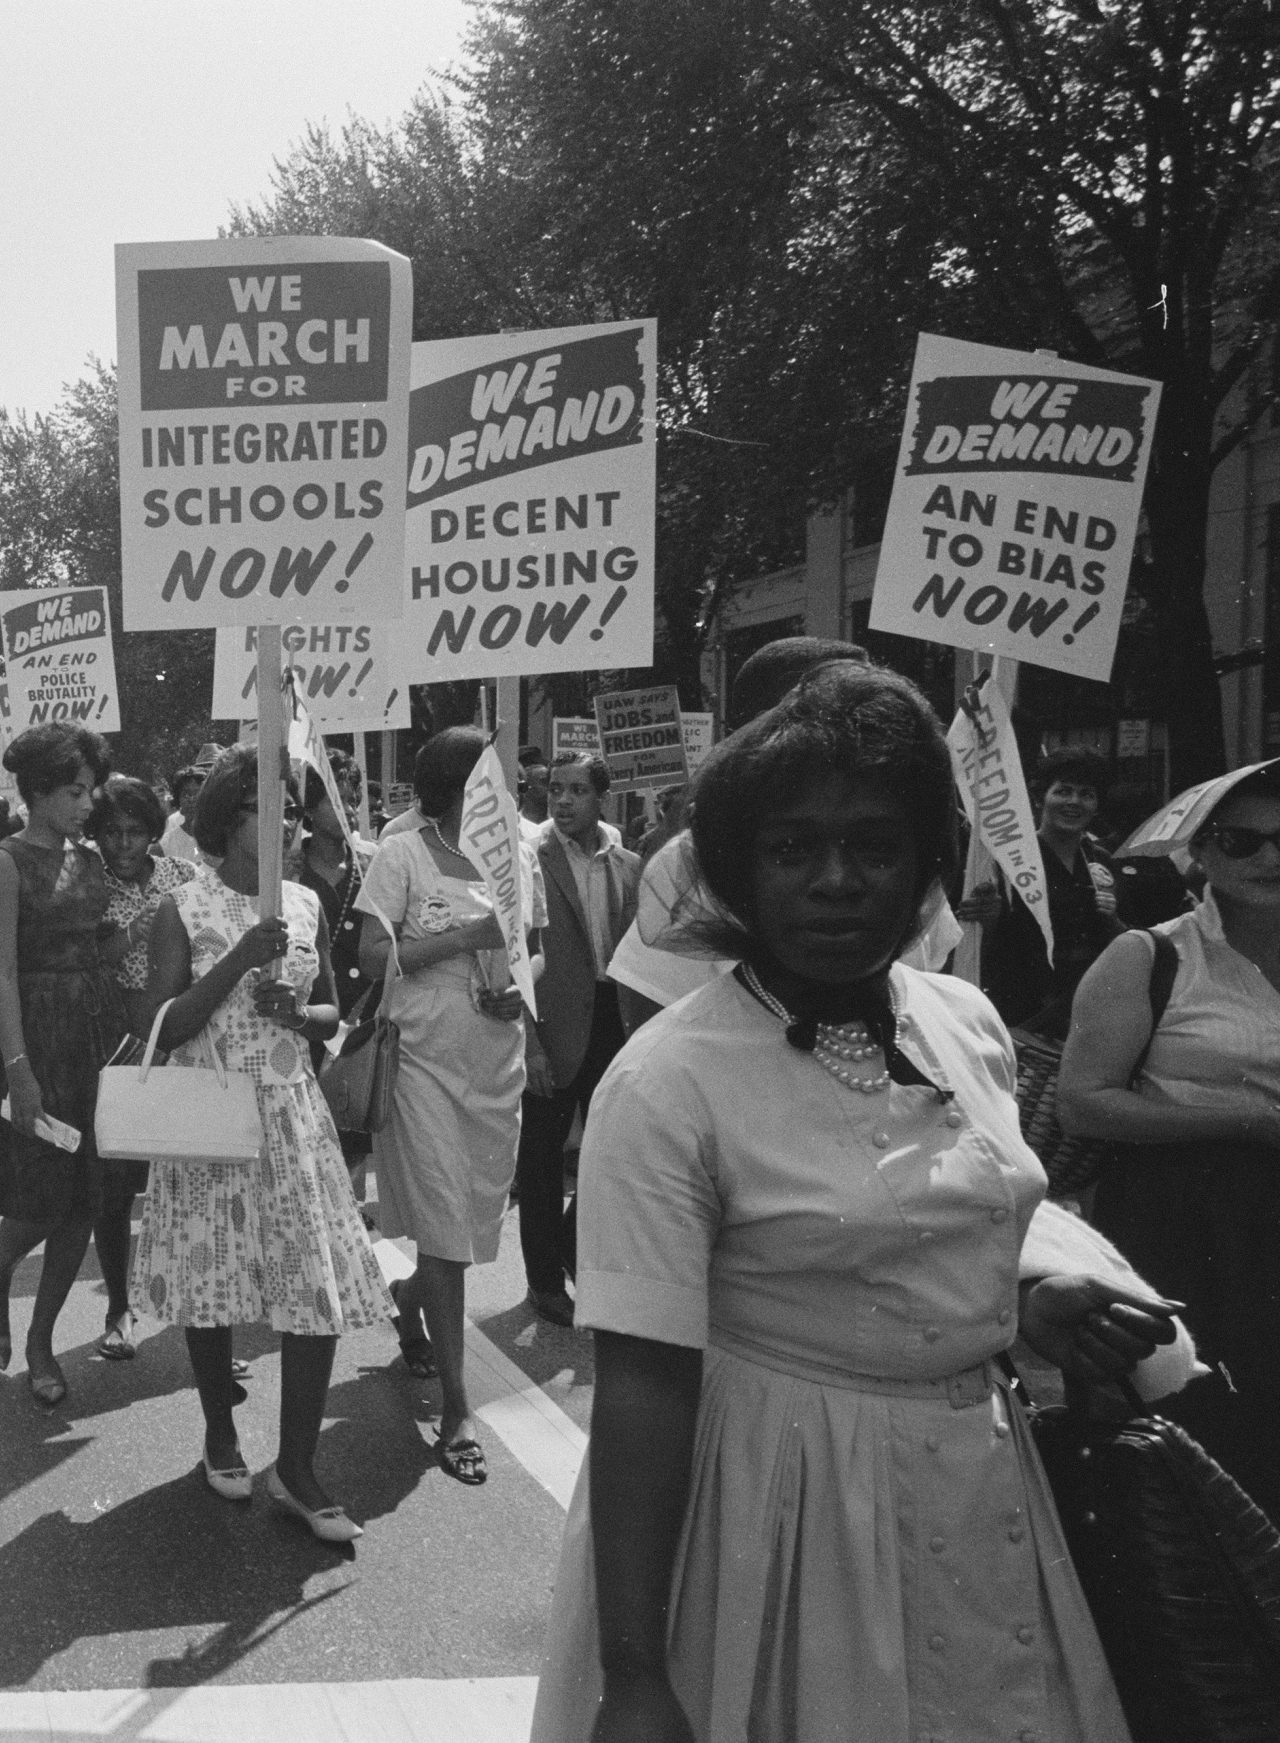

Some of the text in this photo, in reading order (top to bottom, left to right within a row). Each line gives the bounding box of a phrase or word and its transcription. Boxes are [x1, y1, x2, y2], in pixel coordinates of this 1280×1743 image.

[228, 275, 302, 313] WE
[159, 318, 371, 370] MARCH
[226, 375, 307, 399] FOR
[470, 354, 562, 421] WE
[990, 381, 1079, 420] WE
[141, 418, 388, 468] INTEGRATED
[408, 385, 635, 494] DEMAND
[923, 422, 1134, 467] DEMAND
[143, 479, 384, 528] SCHOOLS
[431, 491, 621, 543] DECENT
[922, 484, 1117, 552] AN END
[161, 532, 374, 602] NOW!
[412, 546, 639, 600] HOUSING
[922, 526, 1107, 596] TO BIAS
[37, 596, 73, 622] WE
[426, 585, 628, 656] NOW!
[912, 573, 1101, 645] NOW!
[14, 610, 101, 653] DEMAND
[245, 626, 371, 652] RGHTS
[22, 652, 97, 669] AN END
[40, 672, 86, 687] POLICE
[28, 685, 96, 701] BRUTALITY
[29, 694, 109, 725] NOW!
[603, 697, 635, 710] UAW
[602, 708, 651, 730] JOBS
[604, 728, 679, 754] FREEDOM
[463, 776, 517, 914] FREEDOM
[1008, 849, 1024, 867] IN
[1015, 865, 1043, 905] '63
